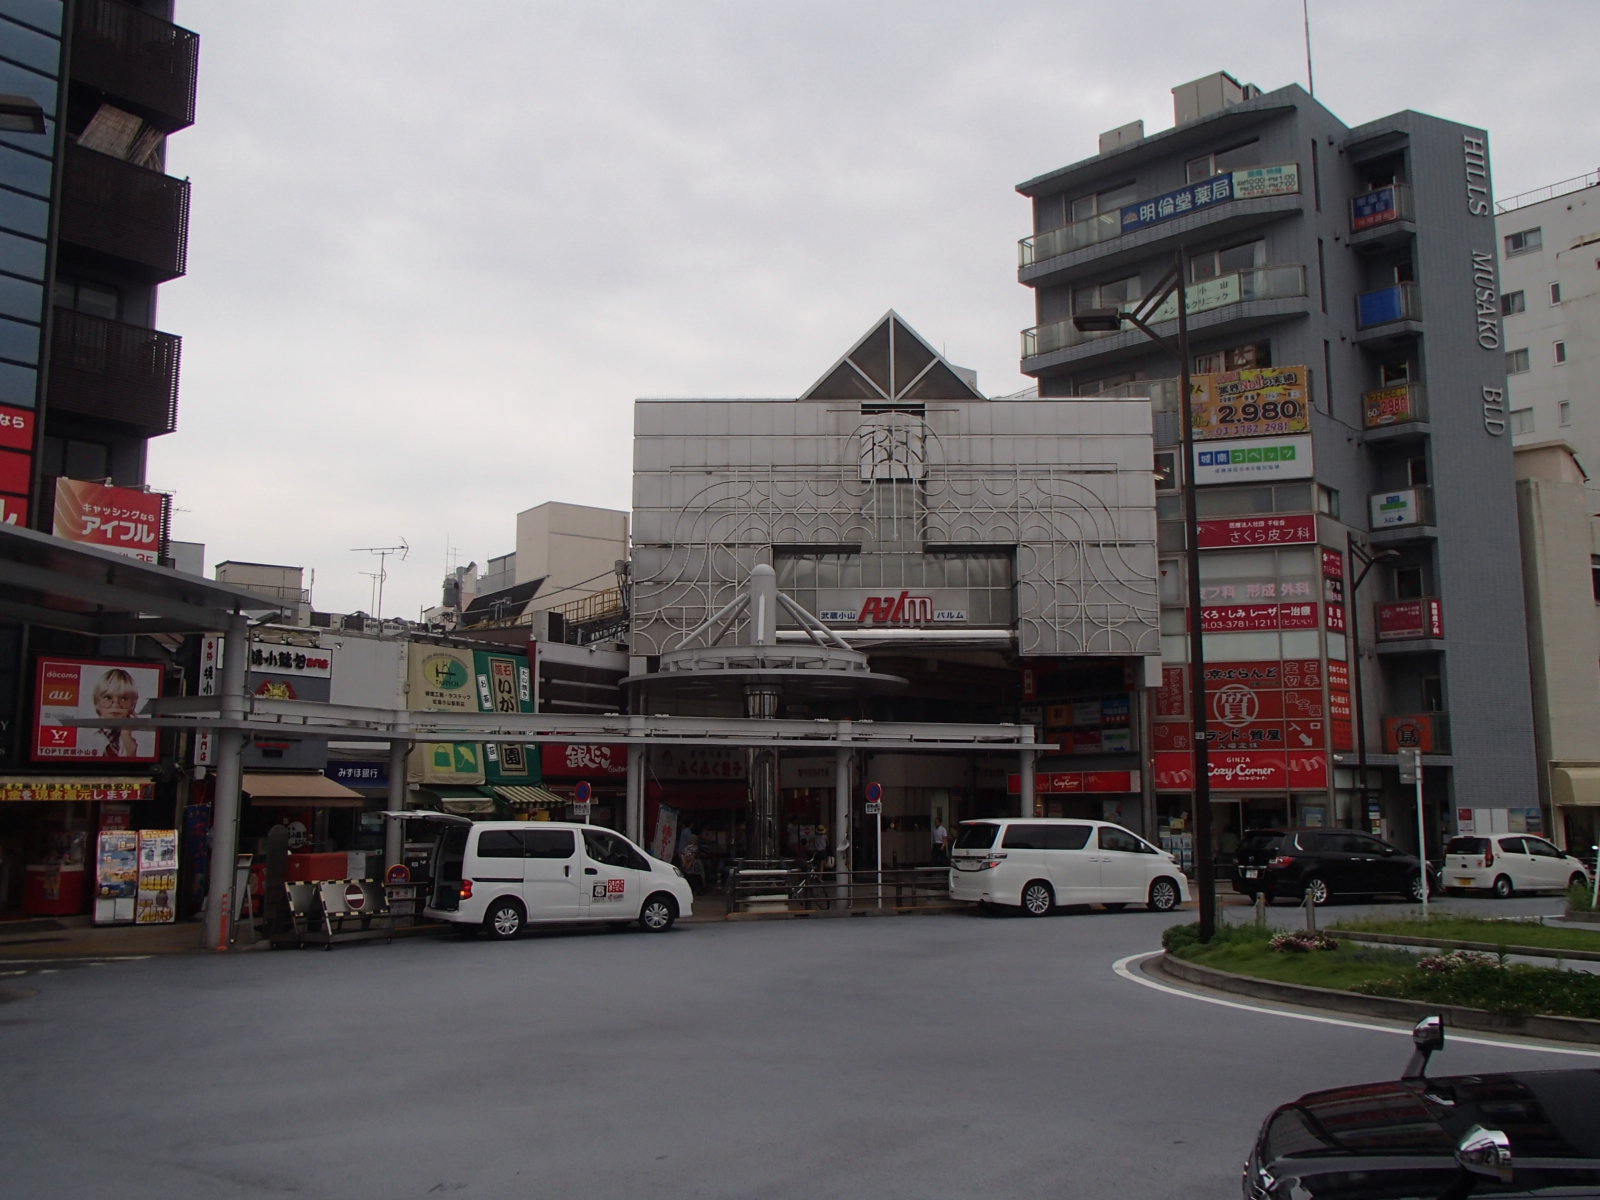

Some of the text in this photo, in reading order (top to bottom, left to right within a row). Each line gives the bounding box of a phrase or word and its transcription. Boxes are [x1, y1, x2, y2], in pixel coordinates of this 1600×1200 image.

[1139, 179, 1230, 222] 明倫堂薬局
[1463, 134, 1505, 437] HILLS MUSAKO BLD
[1199, 447, 1295, 466] 城南コベッツ
[82, 504, 156, 522] キャッシングなら
[81, 516, 155, 544] アイフル
[1229, 527, 1310, 543] さくら皮フ科
[821, 611, 856, 620] 武蔵小山
[46, 671, 79, 680] docomo
[49, 690, 73, 700] au
[1221, 692, 1252, 719] 質
[1206, 728, 1281, 742] ランド・質屋
[565, 744, 612, 769] 銀だこ
[338, 767, 379, 782] みずほ銀行
[1236, 764, 1275, 776] Corner
